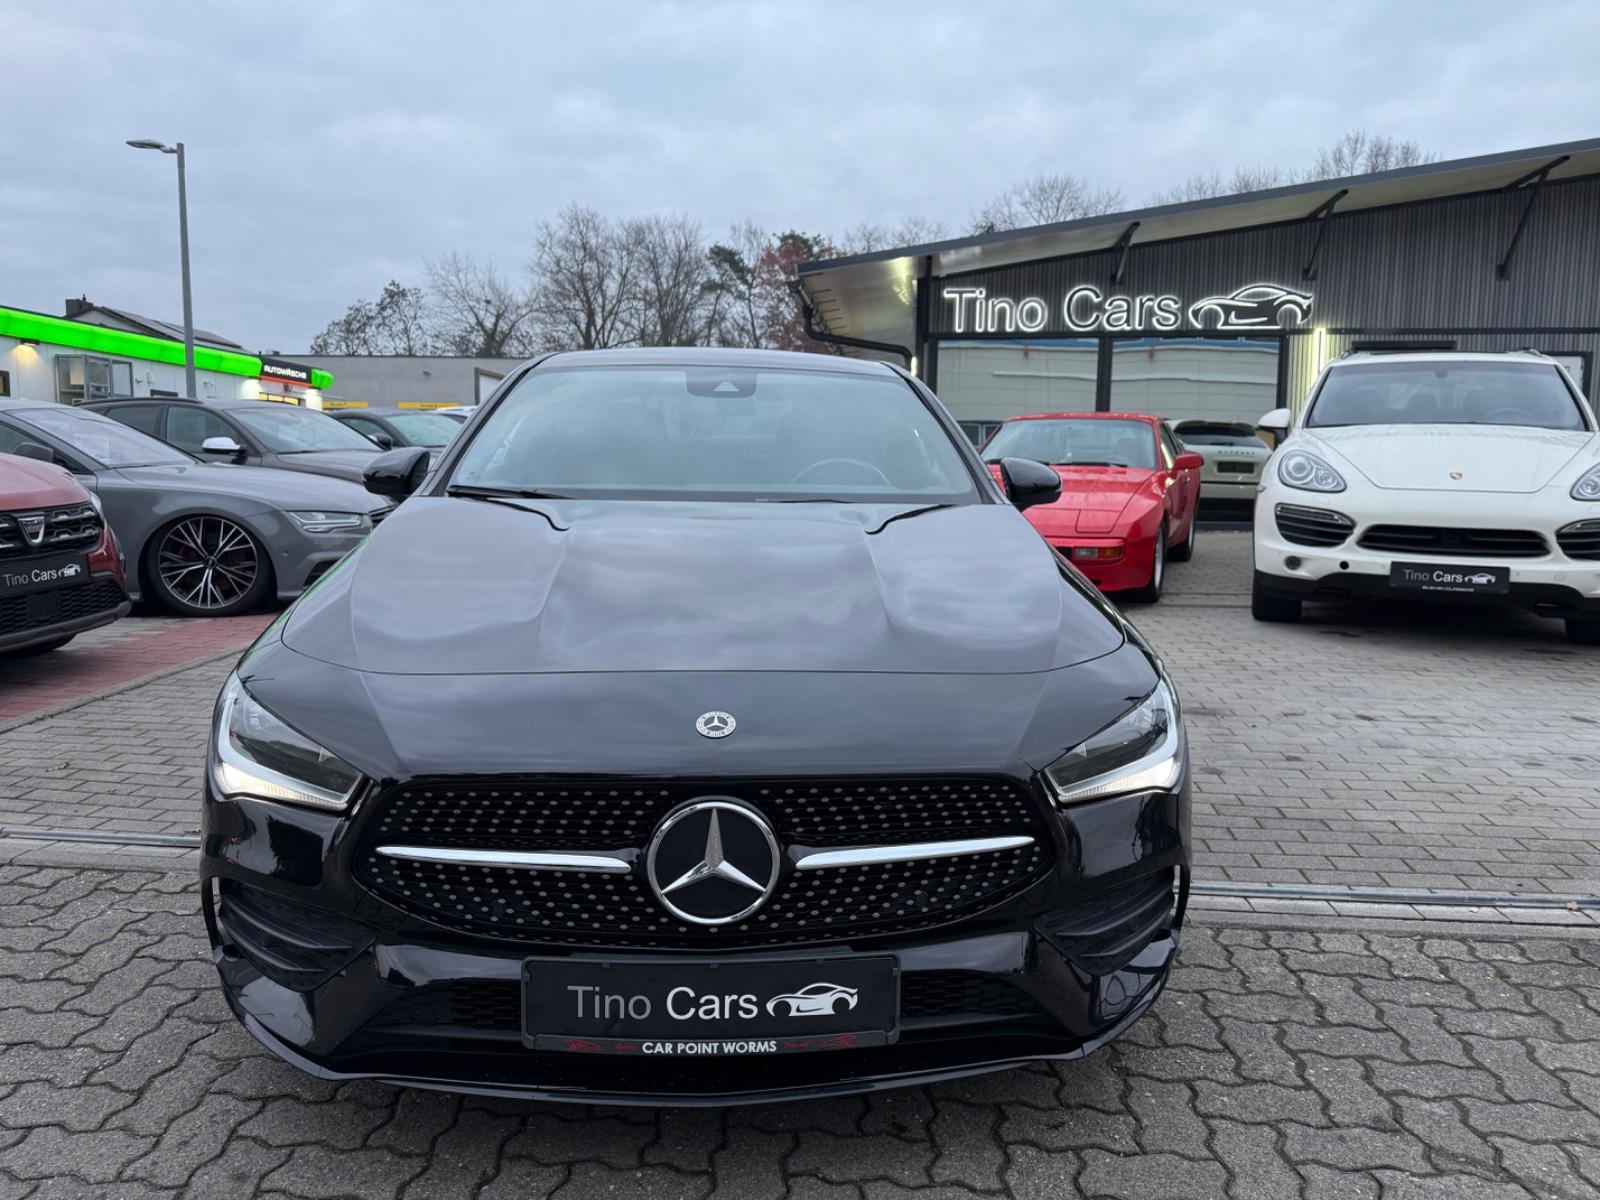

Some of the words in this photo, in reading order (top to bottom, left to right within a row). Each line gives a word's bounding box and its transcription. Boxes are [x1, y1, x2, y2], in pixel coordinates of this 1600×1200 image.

[943, 287, 1048, 333] Tino
[1063, 285, 1182, 332] Cars
[3, 573, 29, 587] Tino
[31, 569, 58, 582] Cars
[1403, 569, 1430, 582] Tino
[1433, 570, 1463, 583] Cars
[567, 985, 652, 1020] Tino
[666, 986, 758, 1020] Cars
[642, 1042, 673, 1054] CAR
[677, 1042, 719, 1054] POINT
[722, 1040, 777, 1054] WORMS
